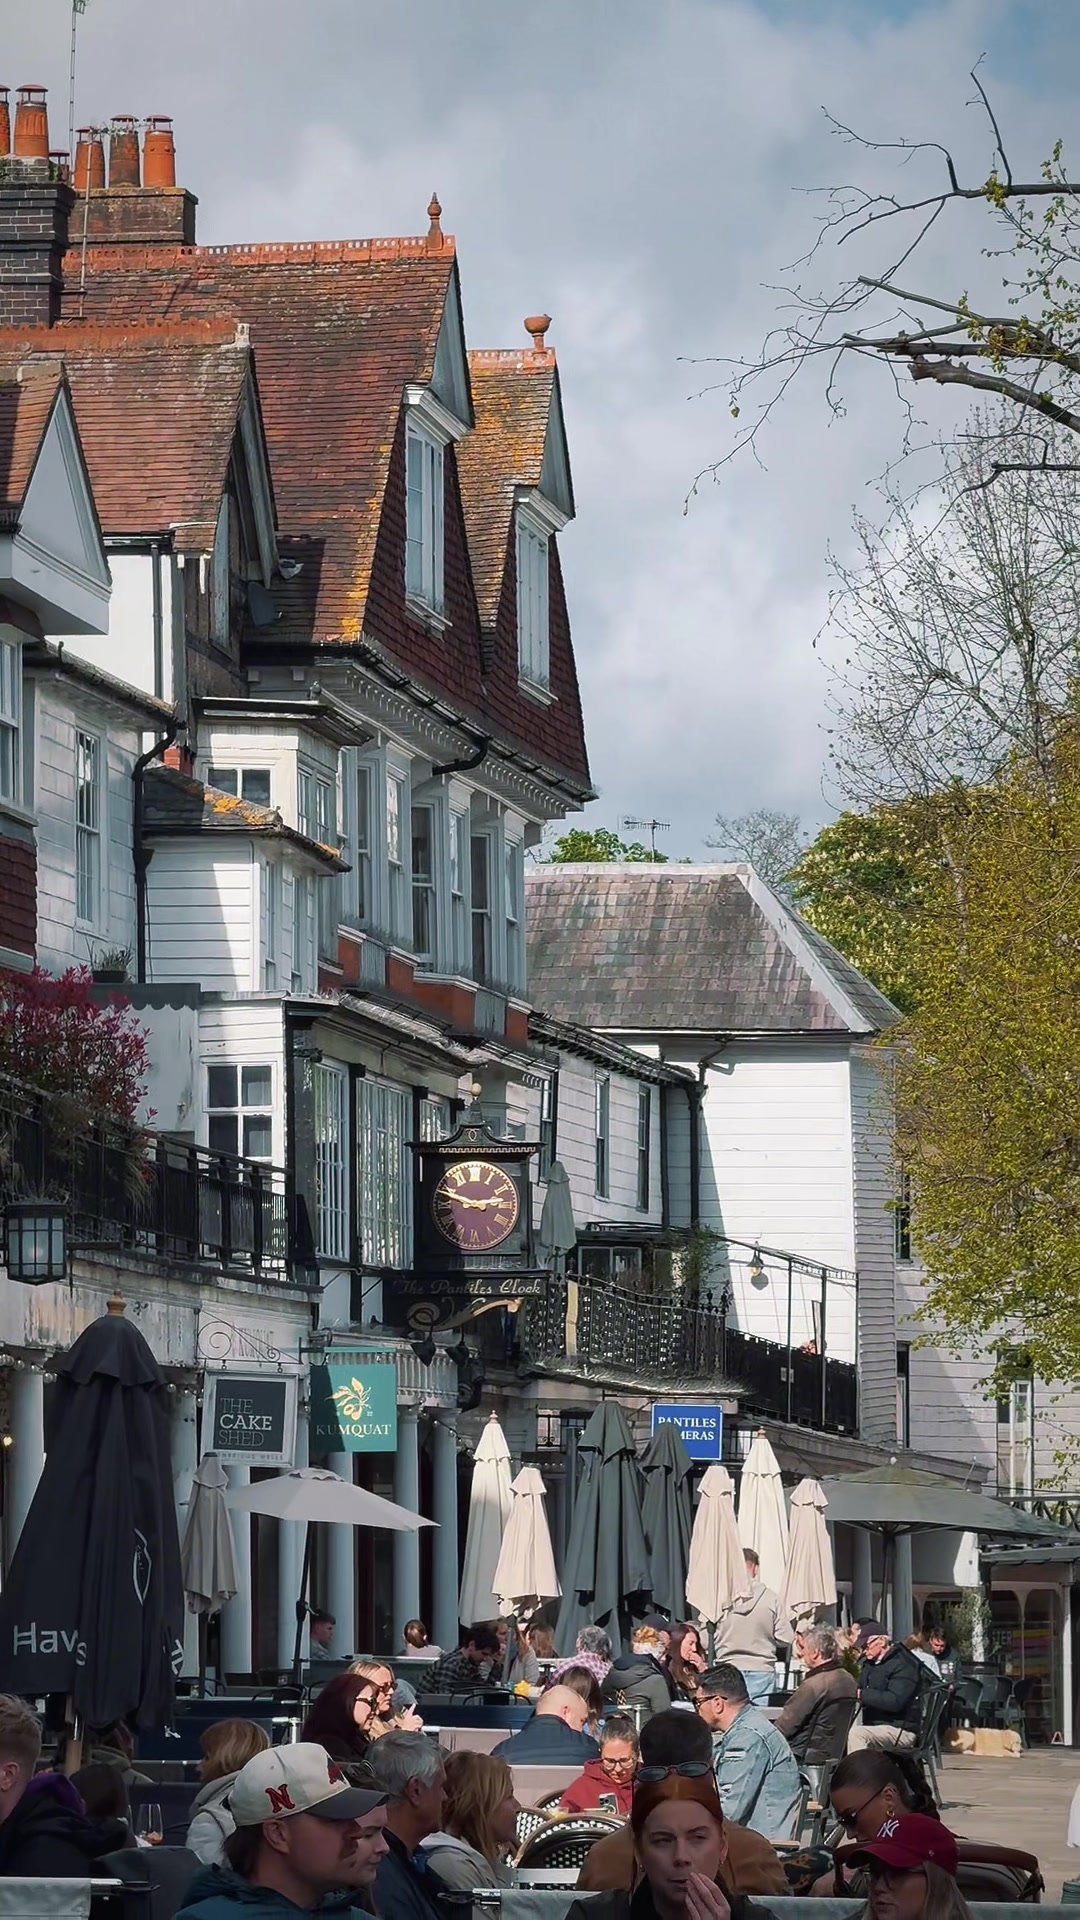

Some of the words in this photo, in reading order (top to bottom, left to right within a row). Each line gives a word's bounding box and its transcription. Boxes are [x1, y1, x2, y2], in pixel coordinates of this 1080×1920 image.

[397, 1278, 425, 1295] The
[430, 1279, 492, 1295] Pantiles
[499, 1278, 541, 1294] Clock
[220, 1398, 253, 1414] THE
[220, 1414, 272, 1430] CAKE
[658, 1417, 716, 1428] PANTILES
[218, 1430, 264, 1446] SHED
[316, 1424, 391, 1438] KUMQUAT
[680, 1430, 714, 1441] MERAS
[265, 1784, 296, 1813] N
[877, 1819, 900, 1838] NY
